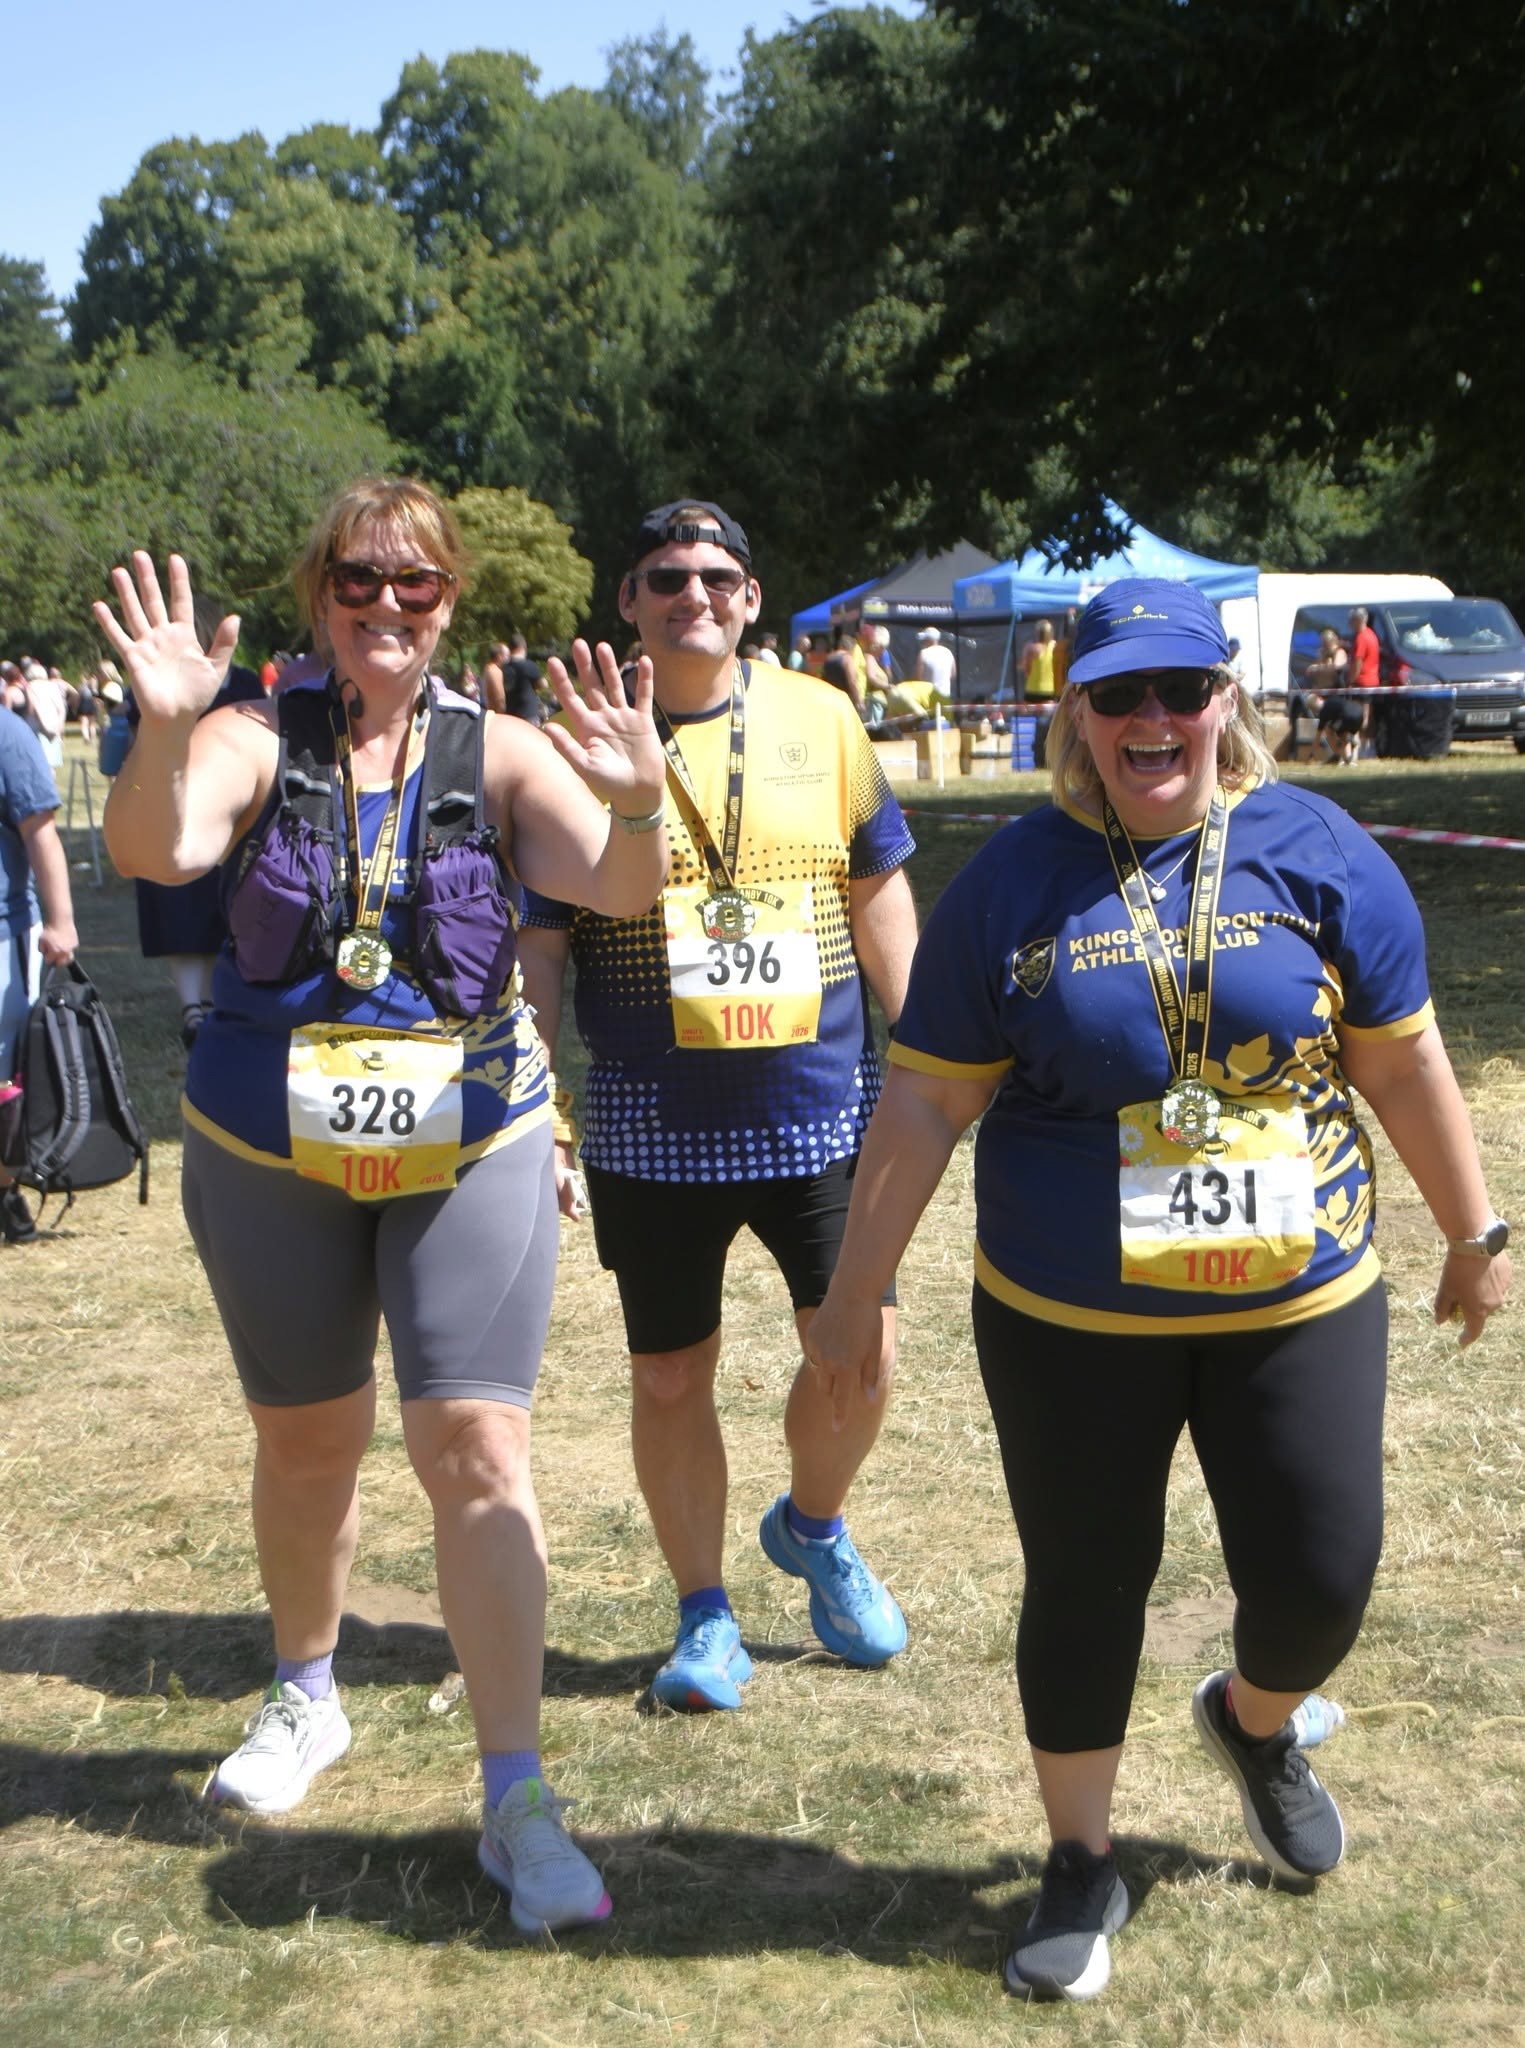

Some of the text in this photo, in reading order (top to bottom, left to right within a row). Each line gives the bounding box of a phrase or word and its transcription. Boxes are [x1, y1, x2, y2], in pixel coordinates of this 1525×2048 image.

[1110, 613, 1168, 626] RONHILL
[726, 835, 737, 853] HALL
[763, 891, 780, 907] 10K
[1194, 875, 1214, 961] NORMANBY HALL 10K
[1069, 924, 1189, 955] KINGSON
[1215, 911, 1265, 932] PON
[1071, 931, 1260, 973] ATHLEIC LUB
[706, 940, 781, 986] 396
[1152, 957, 1176, 1007] NORMANBY
[1166, 1005, 1181, 1032] HALL
[720, 1003, 776, 1041] 10K
[791, 1027, 809, 1039] 2026
[1186, 1053, 1199, 1077] 2026
[328, 1083, 416, 1136] 328
[1242, 1109, 1262, 1126] 10K
[340, 1153, 406, 1194] 10K
[1168, 1169, 1257, 1226] 431
[1183, 1247, 1256, 1288] 10K
